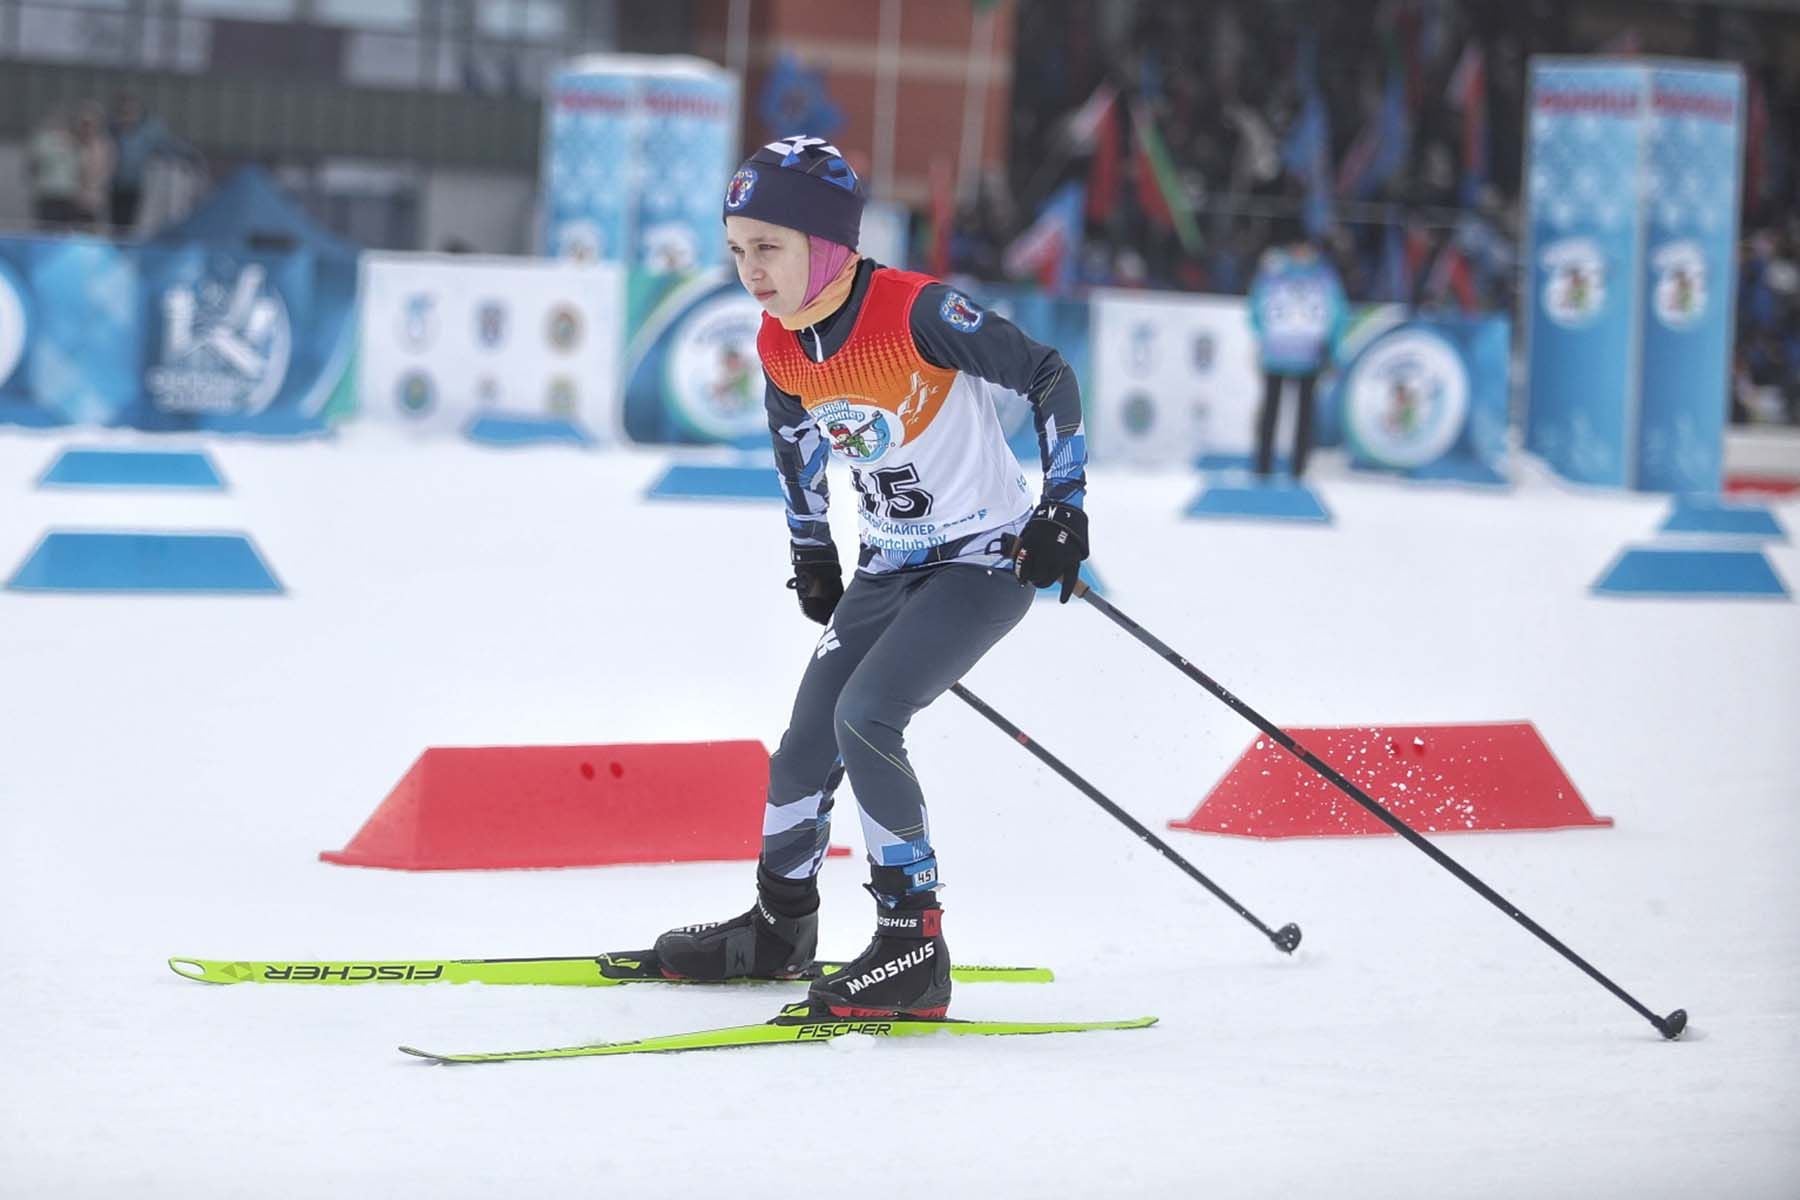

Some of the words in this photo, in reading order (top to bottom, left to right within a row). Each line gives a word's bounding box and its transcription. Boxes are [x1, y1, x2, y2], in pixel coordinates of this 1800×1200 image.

[881, 521, 936, 536] СНАЙПЕР
[868, 534, 947, 551] sportclub.by
[917, 870, 932, 883] 45
[878, 916, 918, 928] DSHUS
[263, 964, 444, 981] FISCHER
[846, 941, 935, 995] MADSHUS
[796, 1023, 892, 1039] FISCHER
